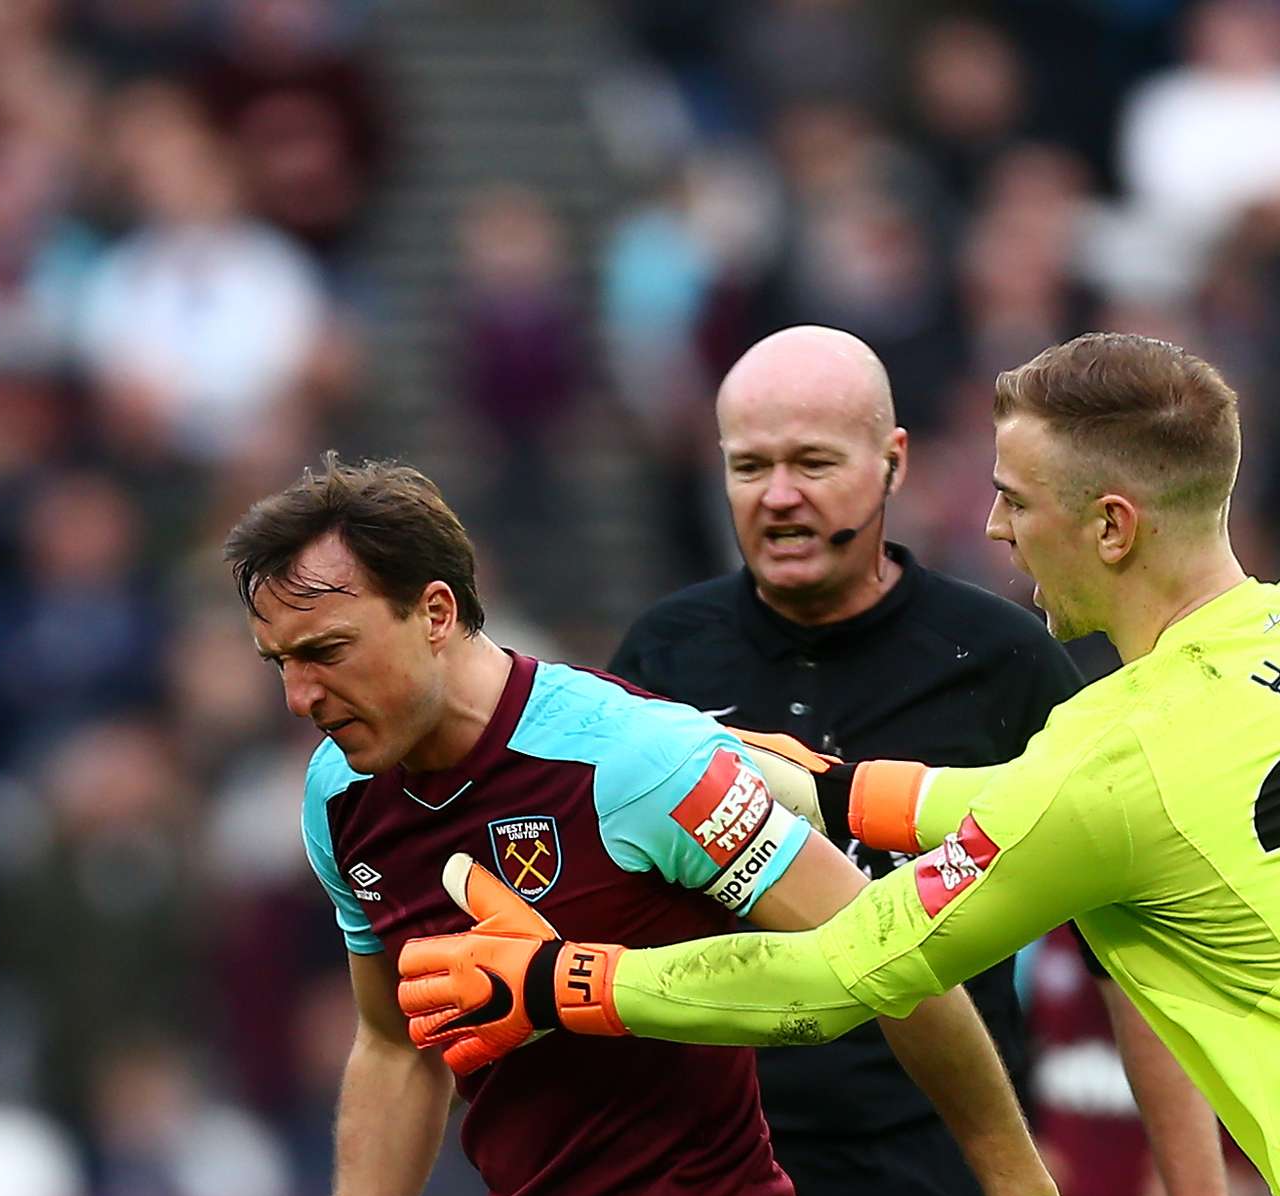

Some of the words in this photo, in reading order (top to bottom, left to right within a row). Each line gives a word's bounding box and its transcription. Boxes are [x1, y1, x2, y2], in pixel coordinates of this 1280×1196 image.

[495, 822, 523, 836] WEST
[524, 821, 550, 832] HAM
[693, 766, 758, 848] MRF
[508, 830, 540, 841] UNITED
[716, 839, 778, 904] aptain
[567, 953, 595, 1003] JH
